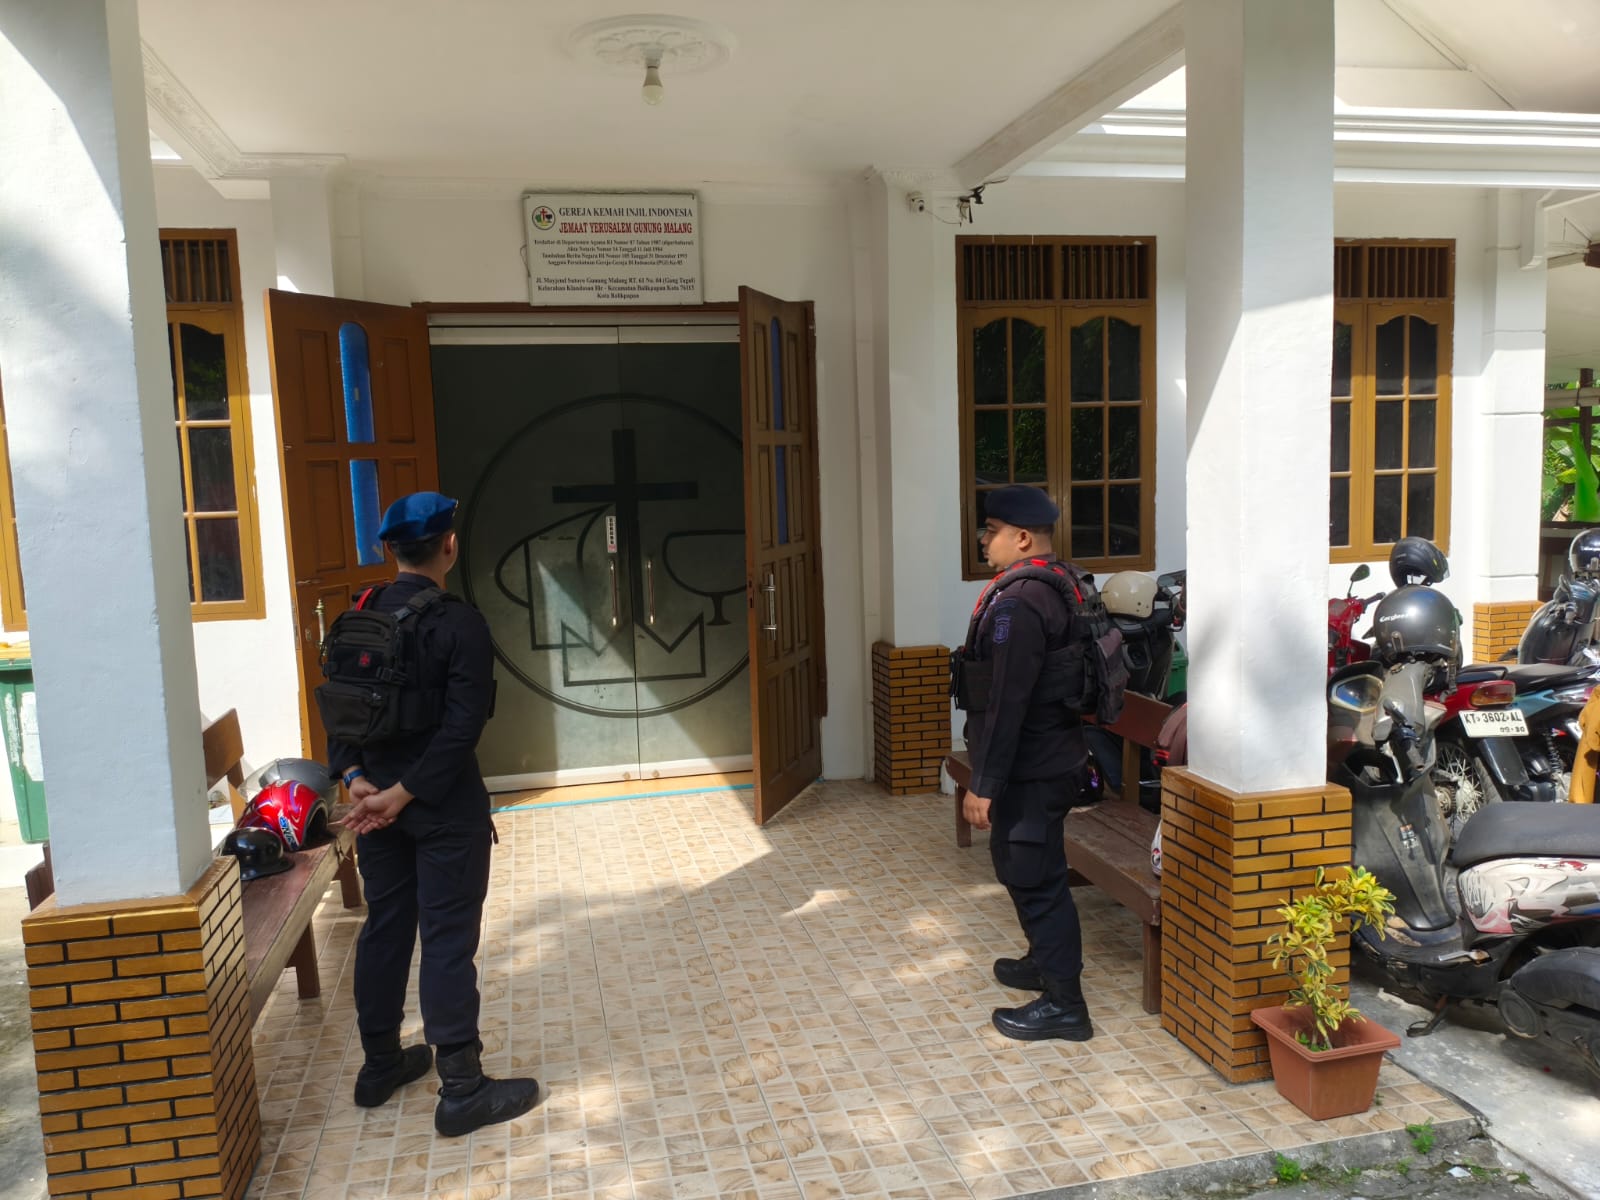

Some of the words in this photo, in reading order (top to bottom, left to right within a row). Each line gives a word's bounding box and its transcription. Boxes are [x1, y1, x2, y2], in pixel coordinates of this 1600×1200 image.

[559, 207, 591, 217] GEREJA
[593, 207, 624, 217] KEMAH
[626, 207, 647, 217] INJIL
[648, 207, 693, 217] INDONESIA
[559, 222, 588, 234] JEMAAT
[590, 222, 632, 234] YERUSALEM
[633, 222, 662, 234] GUNUNG
[664, 222, 692, 234] MALANG
[611, 292, 639, 300] Balikpapan
[1482, 712, 1506, 723] 3602
[1511, 712, 1522, 721] AL
